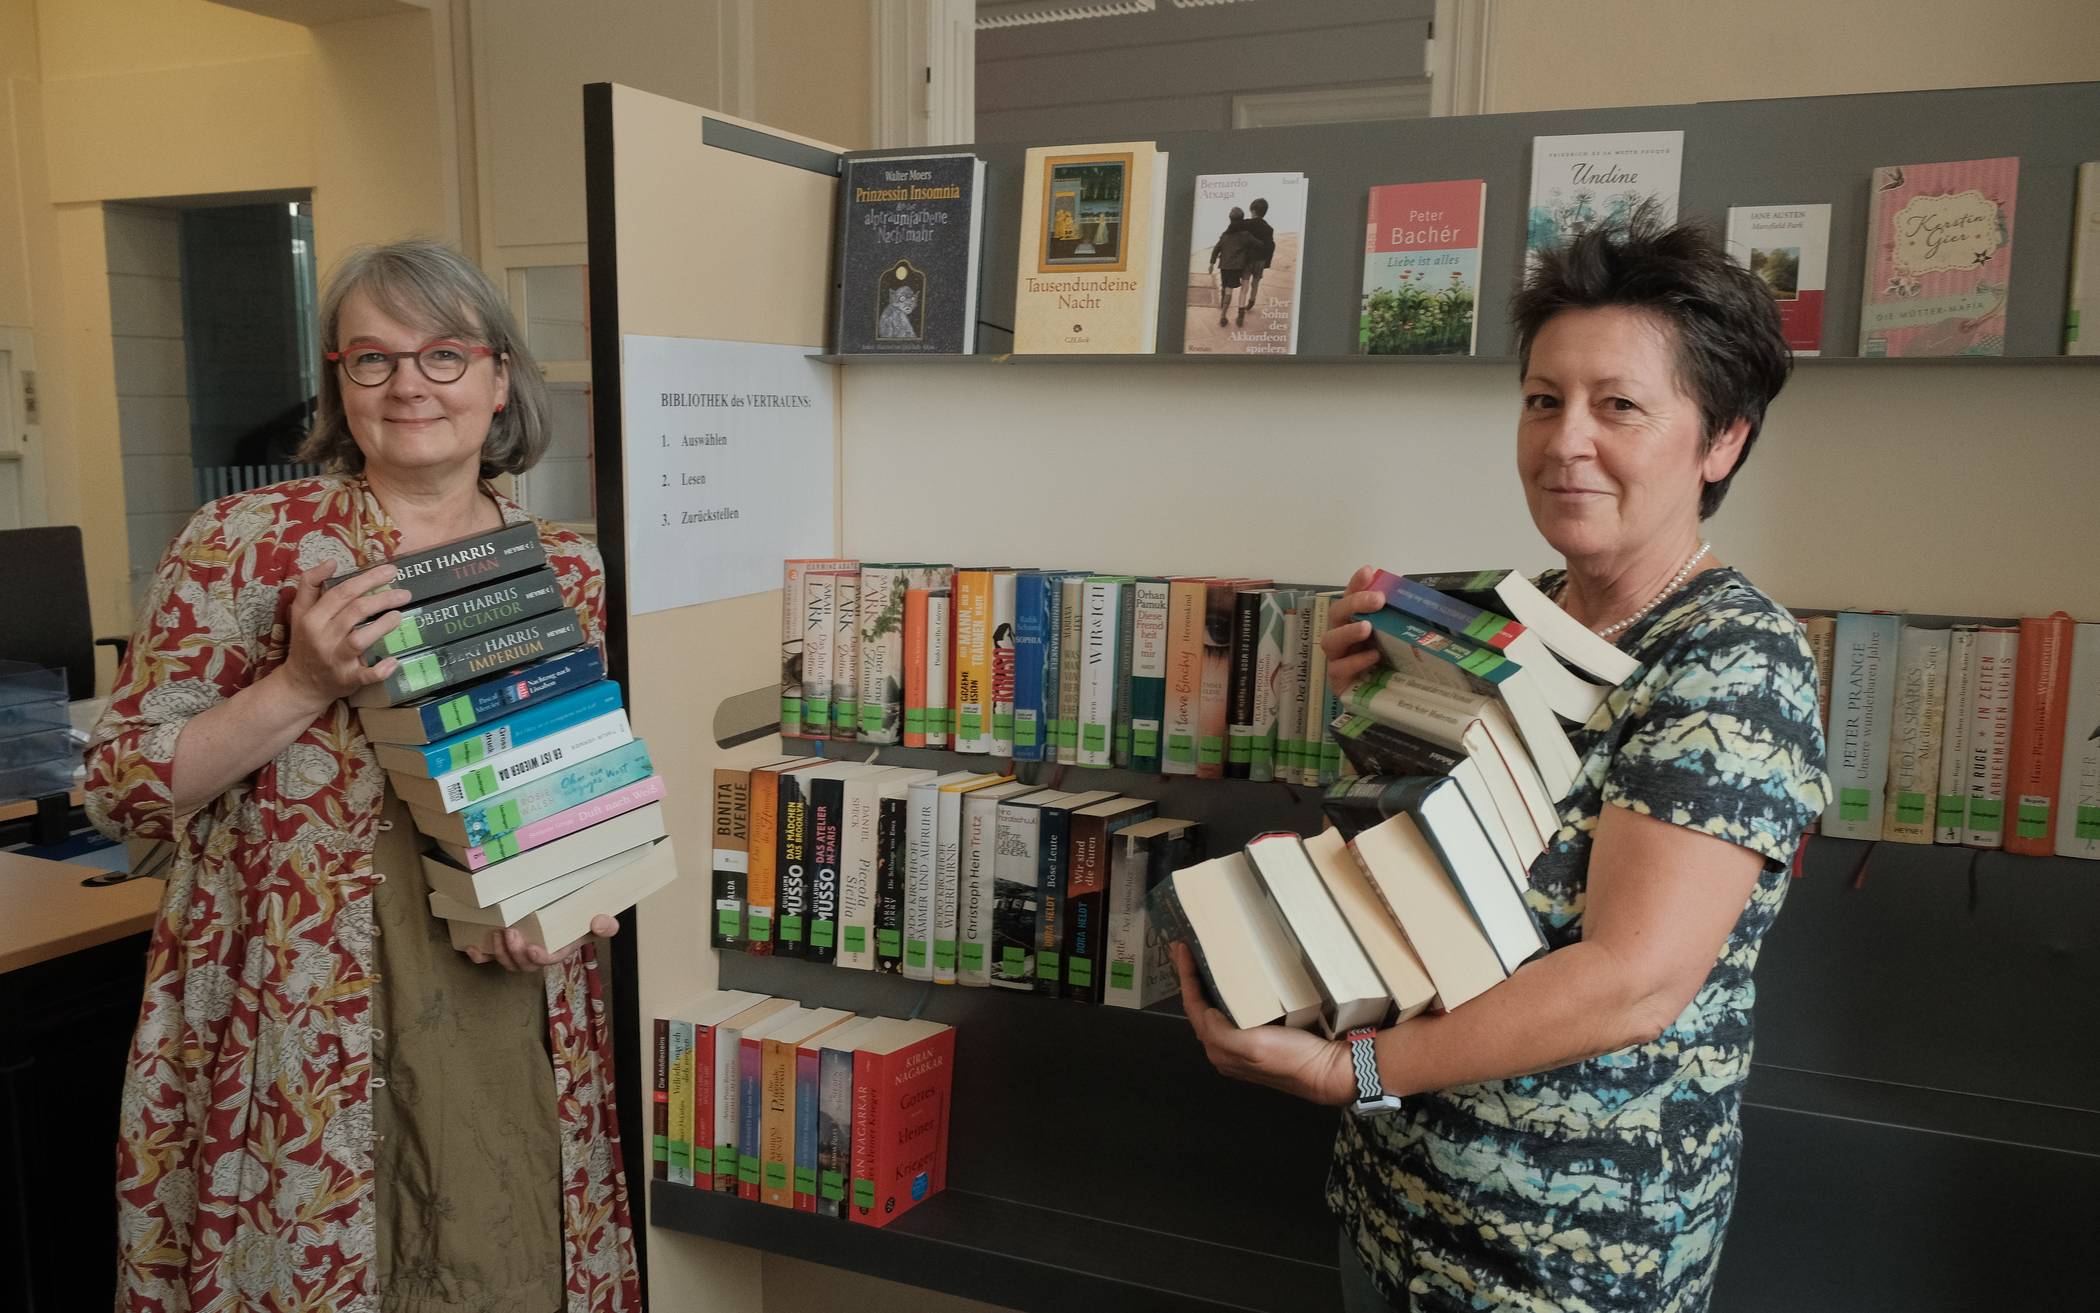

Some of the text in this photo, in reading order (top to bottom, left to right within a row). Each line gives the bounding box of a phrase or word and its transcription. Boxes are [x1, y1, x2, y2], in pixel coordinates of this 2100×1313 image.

[910, 170, 932, 180] Moers
[1200, 178, 1248, 189] Bernardo
[1571, 162, 1639, 185] Undine
[856, 184, 961, 203] Prinzessin Insomnia
[1408, 210, 1444, 222] Peter
[1906, 214, 1986, 238] Kerstin
[1392, 224, 1461, 245] Bachér
[1924, 228, 1969, 260] Gier
[1387, 254, 1460, 267] Liebe ist alles
[1025, 276, 1138, 292] Tausendundeine
[1058, 294, 1101, 309] Nacht
[1262, 309, 1289, 319] Sohn
[1270, 297, 1290, 307] Der
[1230, 331, 1288, 342] Akkordeon
[1269, 320, 1288, 330] des
[1246, 344, 1287, 355] spielers
[660, 393, 812, 408] BIBLIOTHEK des VERTRAUENS:
[661, 433, 728, 448] 1. Auswählen
[662, 472, 706, 487] 2. Lesen
[661, 507, 740, 526] 3. Zurückstellen
[435, 542, 496, 570] HARRIS
[452, 558, 500, 581] TITAN
[462, 587, 518, 615] HARRIS
[808, 582, 823, 632] LARK
[824, 582, 832, 616] SARAH
[864, 574, 879, 624] LARK
[878, 574, 888, 608] SARAH
[1136, 600, 1167, 610] Pamuk
[1137, 589, 1166, 600] Orhan
[444, 601, 524, 635] DICTATOR
[838, 584, 856, 632] LARK
[1052, 590, 1060, 632] HENNING
[1064, 606, 1072, 640] MARIANA
[1138, 611, 1163, 620] Diese
[484, 626, 540, 652] HARRIS
[1016, 636, 1042, 645] SOPHIA
[1136, 620, 1164, 630] Fremd
[1140, 629, 1158, 640] heit
[1242, 609, 1252, 642] MARGRIET
[468, 640, 545, 673] IMPERIUM
[875, 644, 886, 674] Unter
[972, 620, 985, 666] TRÄUMEN
[1050, 633, 1058, 671] MANKELL
[1140, 650, 1157, 658] mir
[1144, 641, 1153, 650] in
[1296, 608, 1311, 703] Der Hals der Giraffe
[816, 634, 828, 687] Das Jahr der
[1174, 594, 1196, 732] Maeve Binchy Herzenskind
[1240, 654, 1250, 672] MOOR
[960, 671, 970, 702] GRAEME
[1254, 658, 1264, 722] KLAUS MODICK
[1904, 668, 1922, 726] SPARKS
[1918, 644, 1938, 760] Mit dir an meiner Seite
[1842, 642, 1865, 770] PETER PRANGE
[1856, 632, 1881, 780] Unsere wunderbaren Jahre
[1974, 655, 1994, 778] RUGE IN ZEITEN
[1990, 657, 2012, 796] ABNEHMENDEN LICHTS
[498, 748, 563, 782] ER IST WIEDER DA
[578, 794, 630, 824] Duft nach
[717, 783, 733, 837] BONITA
[733, 783, 748, 840] AVENUE
[851, 798, 860, 828] SPECK
[862, 806, 870, 842] DANIEL
[786, 801, 796, 860] DAS MÄDCHEN
[794, 802, 804, 861] AUS BROOKLYN
[816, 806, 827, 864] DAS ATELIER
[826, 826, 836, 864] IN PARIS
[918, 806, 932, 890] UND AUFRUHR
[1074, 840, 1086, 884] Wir sind
[1086, 836, 1096, 886] die Guten
[857, 858, 871, 908] Piccola
[908, 842, 918, 904] KIRCHHOFF
[944, 843, 956, 928] WIDERFAHRNIS
[967, 816, 982, 940] Christoph Hein Trutz
[789, 864, 804, 917] MUSSO
[819, 868, 835, 921] MUSSO
[844, 876, 856, 918] Sicilia
[1044, 834, 1058, 948] DORA HELDT Böse Leute
[1076, 902, 1088, 954] DORA HELDT
[1122, 918, 1132, 932] Der
[658, 1036, 666, 1089] Die Middlesteins
[672, 1032, 682, 1095] Vielleicht ich
[895, 1056, 944, 1086] NAGARKAR
[906, 1048, 934, 1069] KIRAN
[900, 1086, 936, 1110] Gottes
[856, 1086, 868, 1155] NAGARKAR
[898, 1118, 935, 1146] kleiner
[896, 1151, 936, 1182] Krieger
